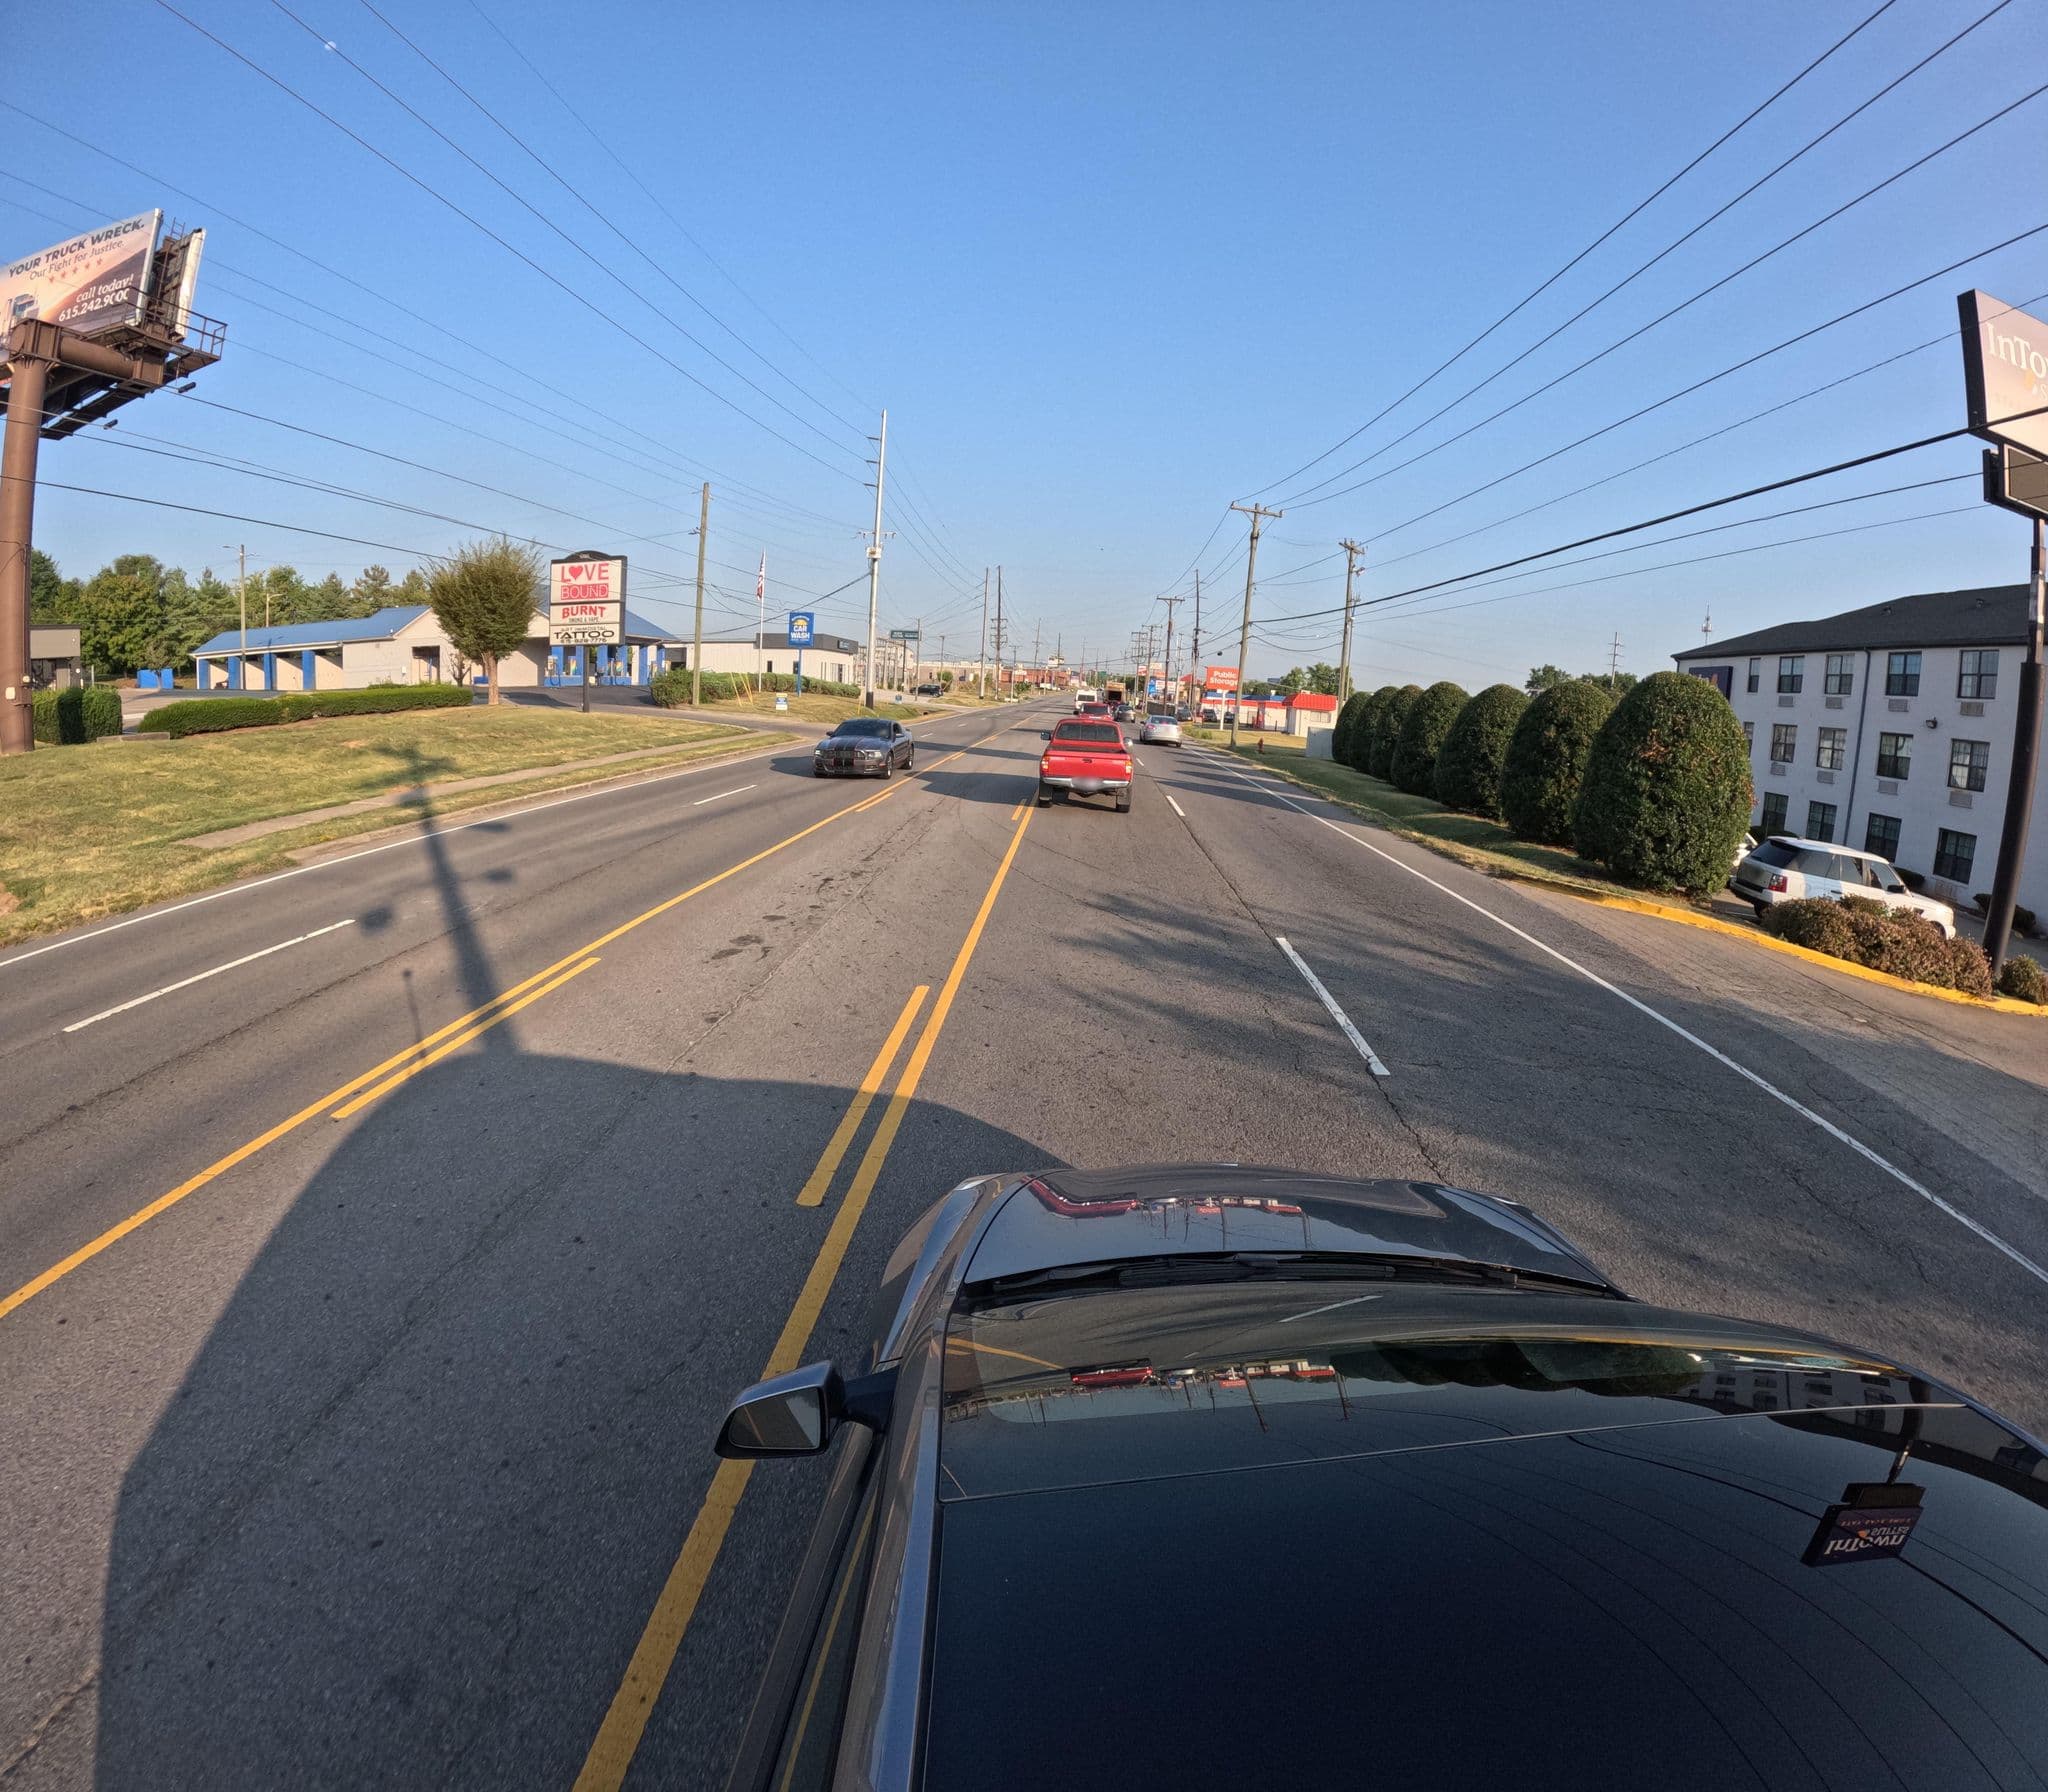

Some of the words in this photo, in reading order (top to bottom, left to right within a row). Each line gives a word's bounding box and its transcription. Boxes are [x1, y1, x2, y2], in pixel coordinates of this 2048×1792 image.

[9, 254, 41, 278] YOUR
[45, 237, 86, 264] TRUCK
[91, 218, 145, 247] WRECK.
[29, 267, 47, 281] Our
[48, 256, 72, 274] Fight
[73, 250, 88, 264] for
[76, 285, 97, 303] call
[98, 273, 134, 296] today!
[1985, 321, 2048, 379] InTo
[561, 583, 609, 600] BOUND
[562, 605, 606, 619] BURNT
[554, 630, 615, 639] TATTOO
